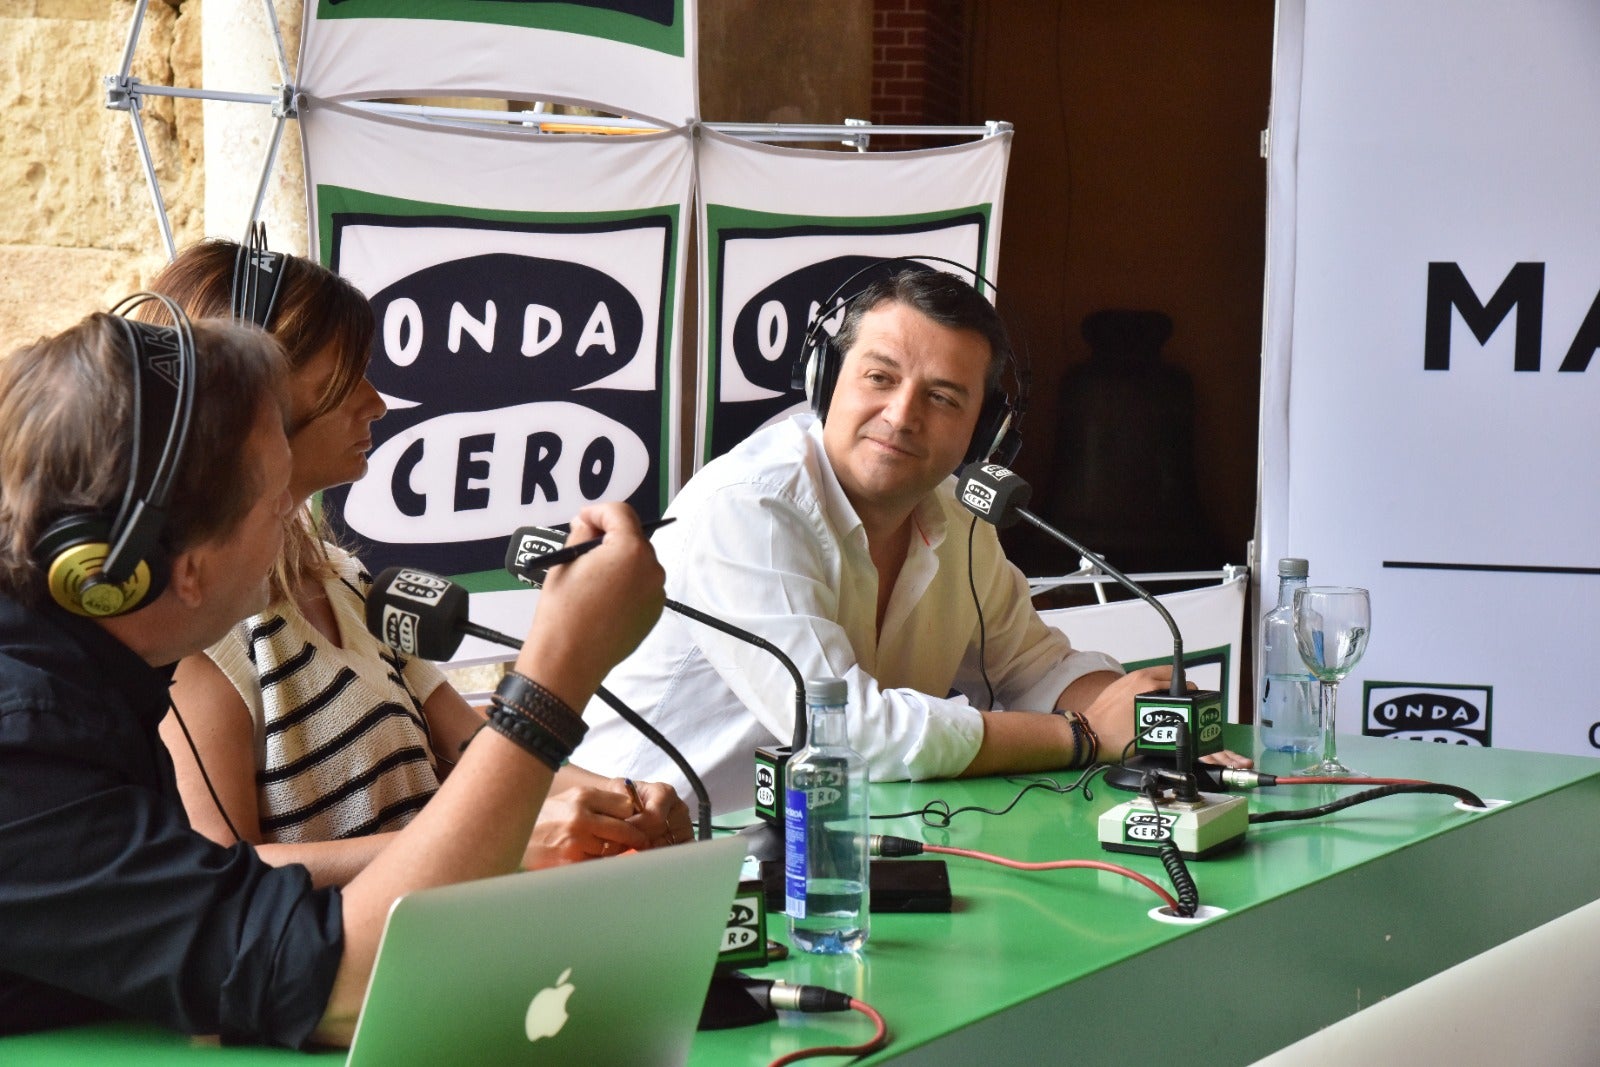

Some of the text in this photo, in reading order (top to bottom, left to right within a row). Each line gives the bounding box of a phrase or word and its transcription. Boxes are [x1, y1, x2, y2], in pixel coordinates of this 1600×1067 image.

[383, 297, 616, 367] ONDA
[757, 297, 845, 361] ON
[138, 324, 181, 389] AK
[391, 431, 615, 517] CERO
[970, 485, 991, 499] ONDA
[967, 494, 987, 508] CERO
[405, 574, 439, 587] CERO
[399, 583, 434, 598] ONDA
[1383, 704, 1469, 721] ONDA
[1148, 730, 1173, 739] CER
[759, 772, 772, 784] ONDA
[759, 790, 772, 802] CERO
[807, 790, 836, 804] ERO
[728, 931, 749, 945] RO
